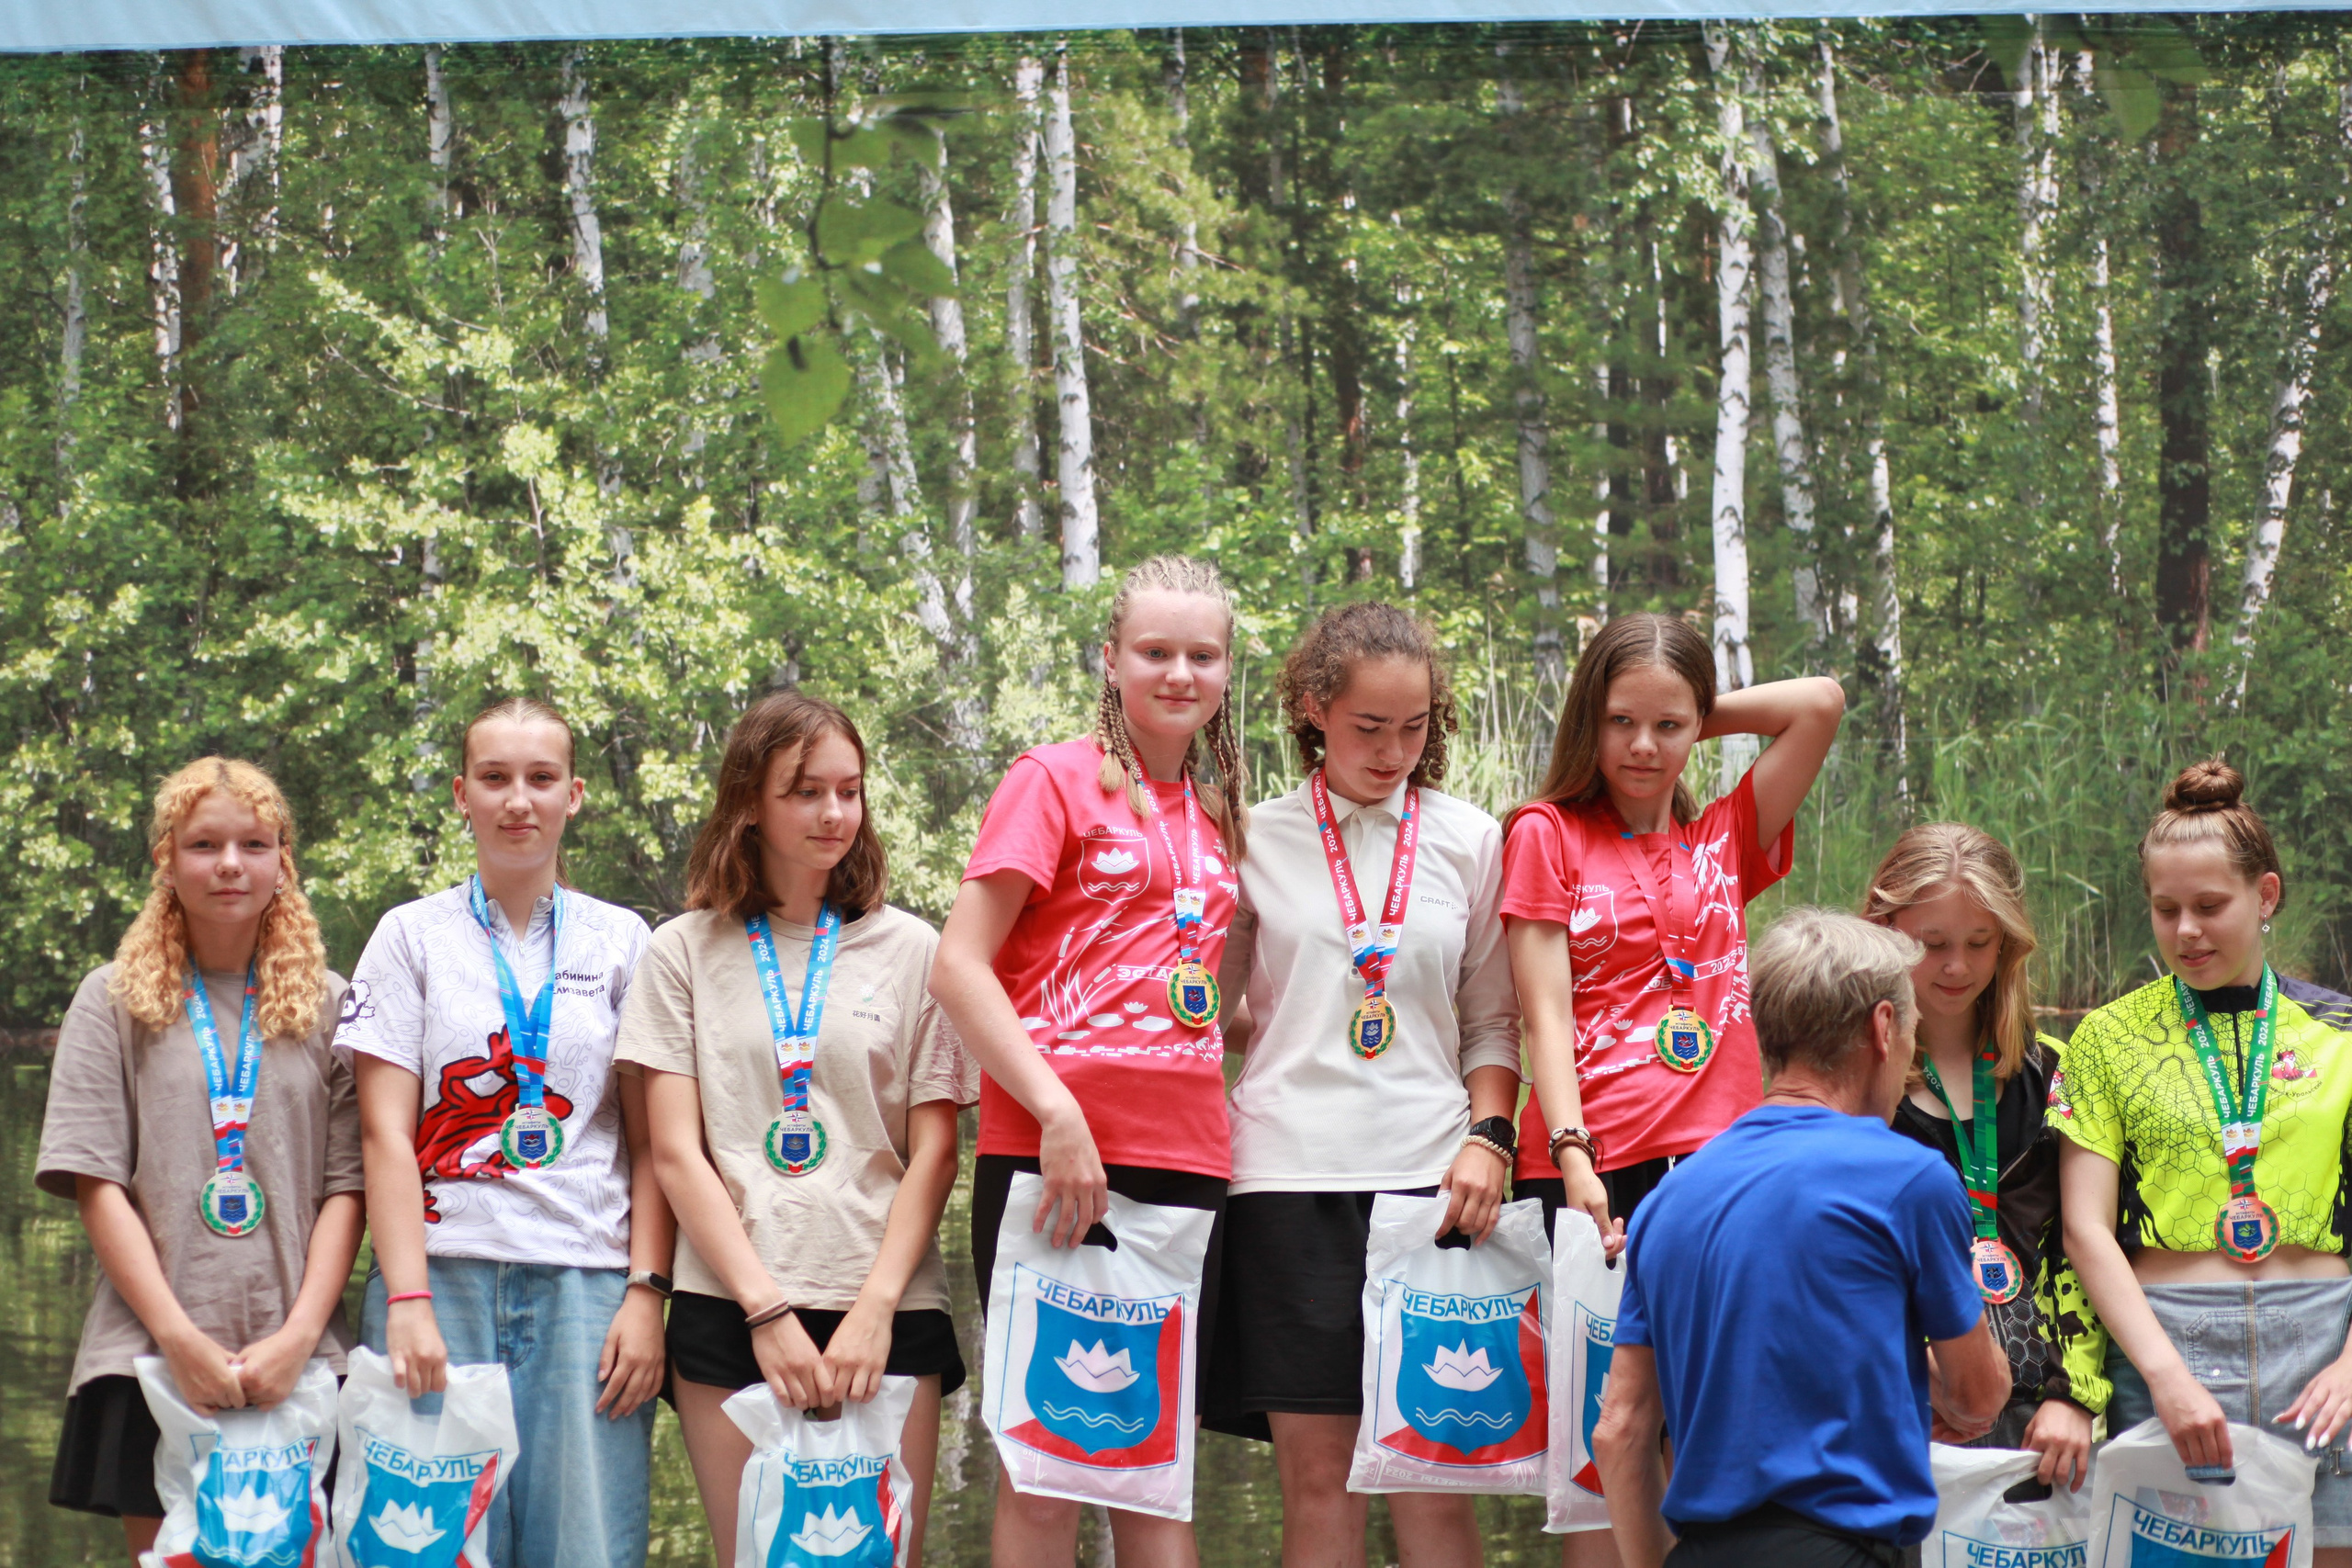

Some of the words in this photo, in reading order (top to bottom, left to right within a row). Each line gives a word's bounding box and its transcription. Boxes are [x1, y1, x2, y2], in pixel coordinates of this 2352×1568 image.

[1144, 789, 1159, 813] 2024
[1189, 799, 1197, 823] 2024
[1315, 775, 1327, 819] ЧЕБАРКУ
[1083, 827, 1143, 838] ЧЕБАРКУЛЬ
[1325, 828, 1339, 852] 2024
[1159, 820, 1182, 884] ЧЕБАРКУЛЬ
[1192, 829, 1201, 885] ЧЕБАРКУЛЬ
[1388, 853, 1409, 917] ЧЕБАРКУЛЬ
[1403, 821, 1414, 848] 2024
[1334, 859, 1357, 921] ЧЕБАРКУЛЬ
[1420, 896, 1451, 908] CRAFT
[758, 938, 771, 963] 2024
[555, 969, 604, 982] абинина
[802, 969, 823, 1031] ЧЕБАРКУЛЬ
[817, 938, 831, 963] 2024
[1116, 968, 1173, 980] ЭСТА
[194, 995, 207, 1020] 2024
[766, 969, 787, 1032] ЧЕБАРКУЛЬ
[2193, 1024, 2210, 1049] 2024
[202, 1026, 222, 1091] ЧЕБАРКУЛЬ
[238, 1032, 256, 1092] ЧЕБАРКУЛ
[2246, 1053, 2265, 1118] ЧЕБАРКУЛЬ
[2257, 1021, 2270, 1046] 2024
[1922, 1066, 1942, 1090] 2024
[2206, 1055, 2231, 1119] ЧЕБАРКУЛЬ
[1036, 1278, 1170, 1322] ЧЕБАРКУЛЬ
[1402, 1288, 1525, 1321] ЧЕБАРКУЛЬ
[2133, 1508, 2276, 1555] ЧЕБАРКУЛЬ
[1967, 1542, 2087, 1568] ЧЕБАРКУЛ
